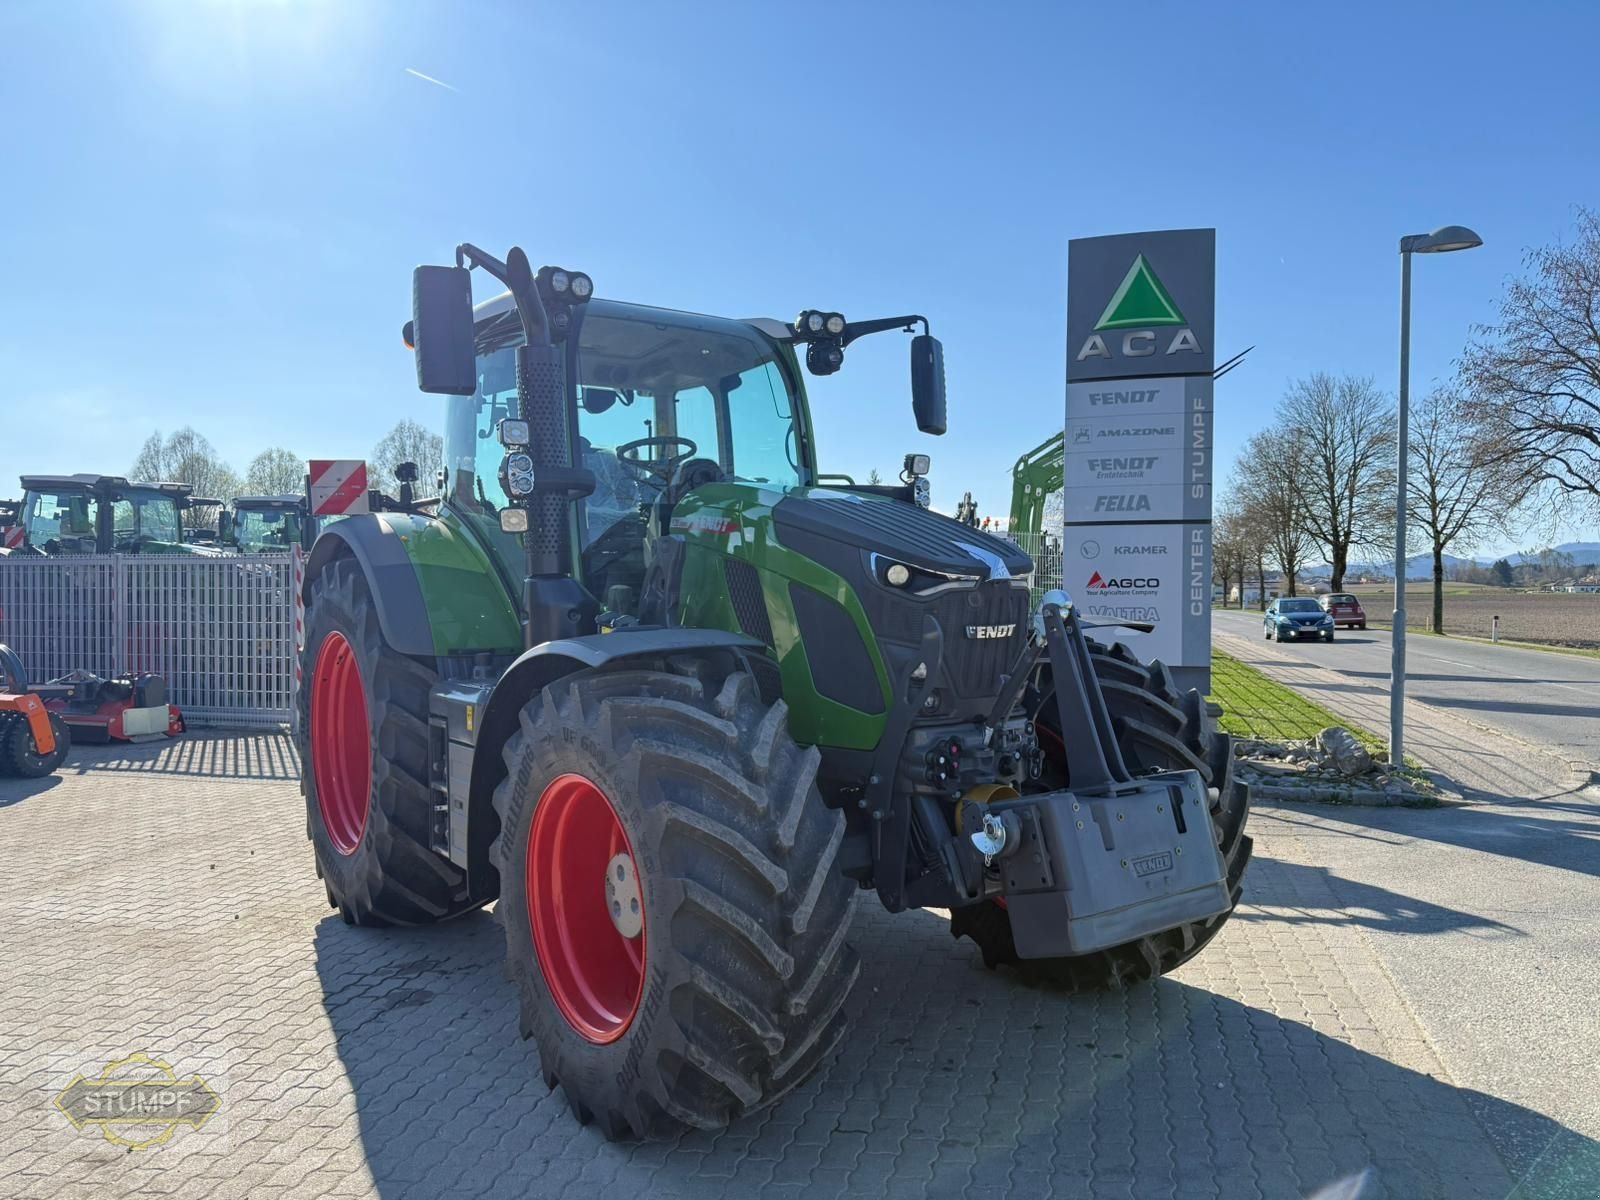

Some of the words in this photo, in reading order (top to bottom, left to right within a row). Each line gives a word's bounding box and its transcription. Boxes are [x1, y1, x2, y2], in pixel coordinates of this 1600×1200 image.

[1076, 328, 1203, 361] ACA
[1088, 389, 1160, 405] FENDT
[1096, 427, 1176, 438] AMAZONE
[1192, 397, 1206, 499] STUMPF
[1087, 456, 1159, 472] FENDT
[1096, 471, 1144, 480] Erntetechnik
[1094, 494, 1151, 512] FELLA
[1113, 545, 1168, 555] KRAMER
[1191, 528, 1204, 616] CENTER
[1107, 578, 1160, 589] AGCO
[1087, 605, 1160, 622] VALTRA
[965, 623, 1017, 639] FENDT
[500, 744, 536, 861] TRELLEBORG
